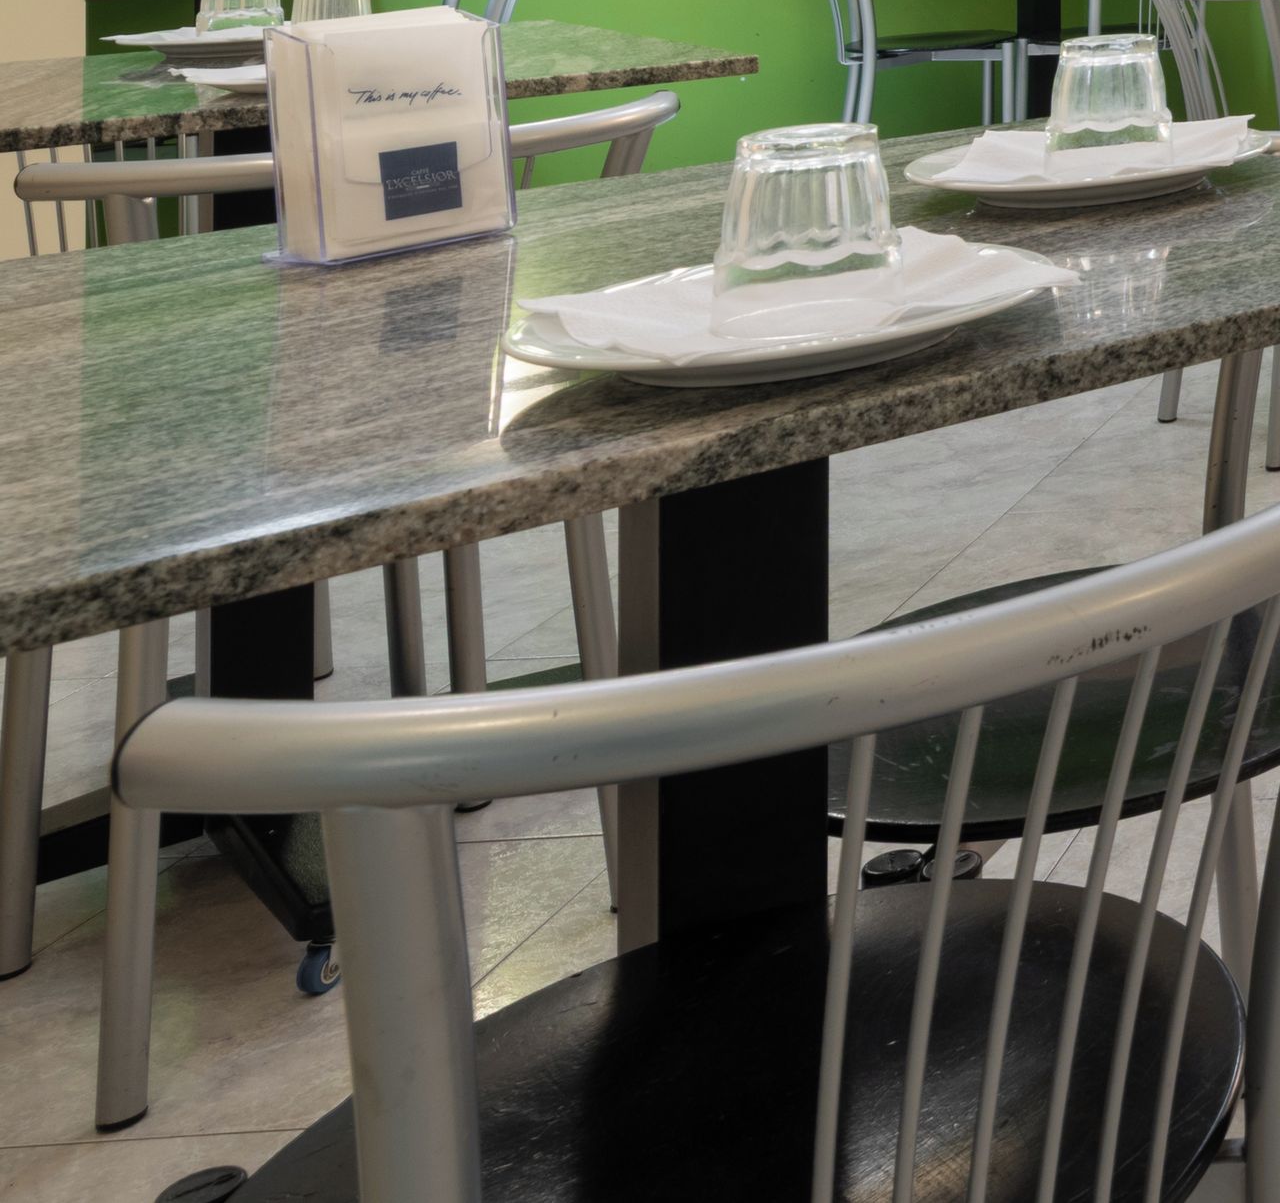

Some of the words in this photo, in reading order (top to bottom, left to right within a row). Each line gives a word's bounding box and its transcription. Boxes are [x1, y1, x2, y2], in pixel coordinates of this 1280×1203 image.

[347, 88, 381, 105] This
[385, 89, 396, 101] is
[398, 91, 419, 106] my
[386, 170, 456, 190] EXCELSIOR
